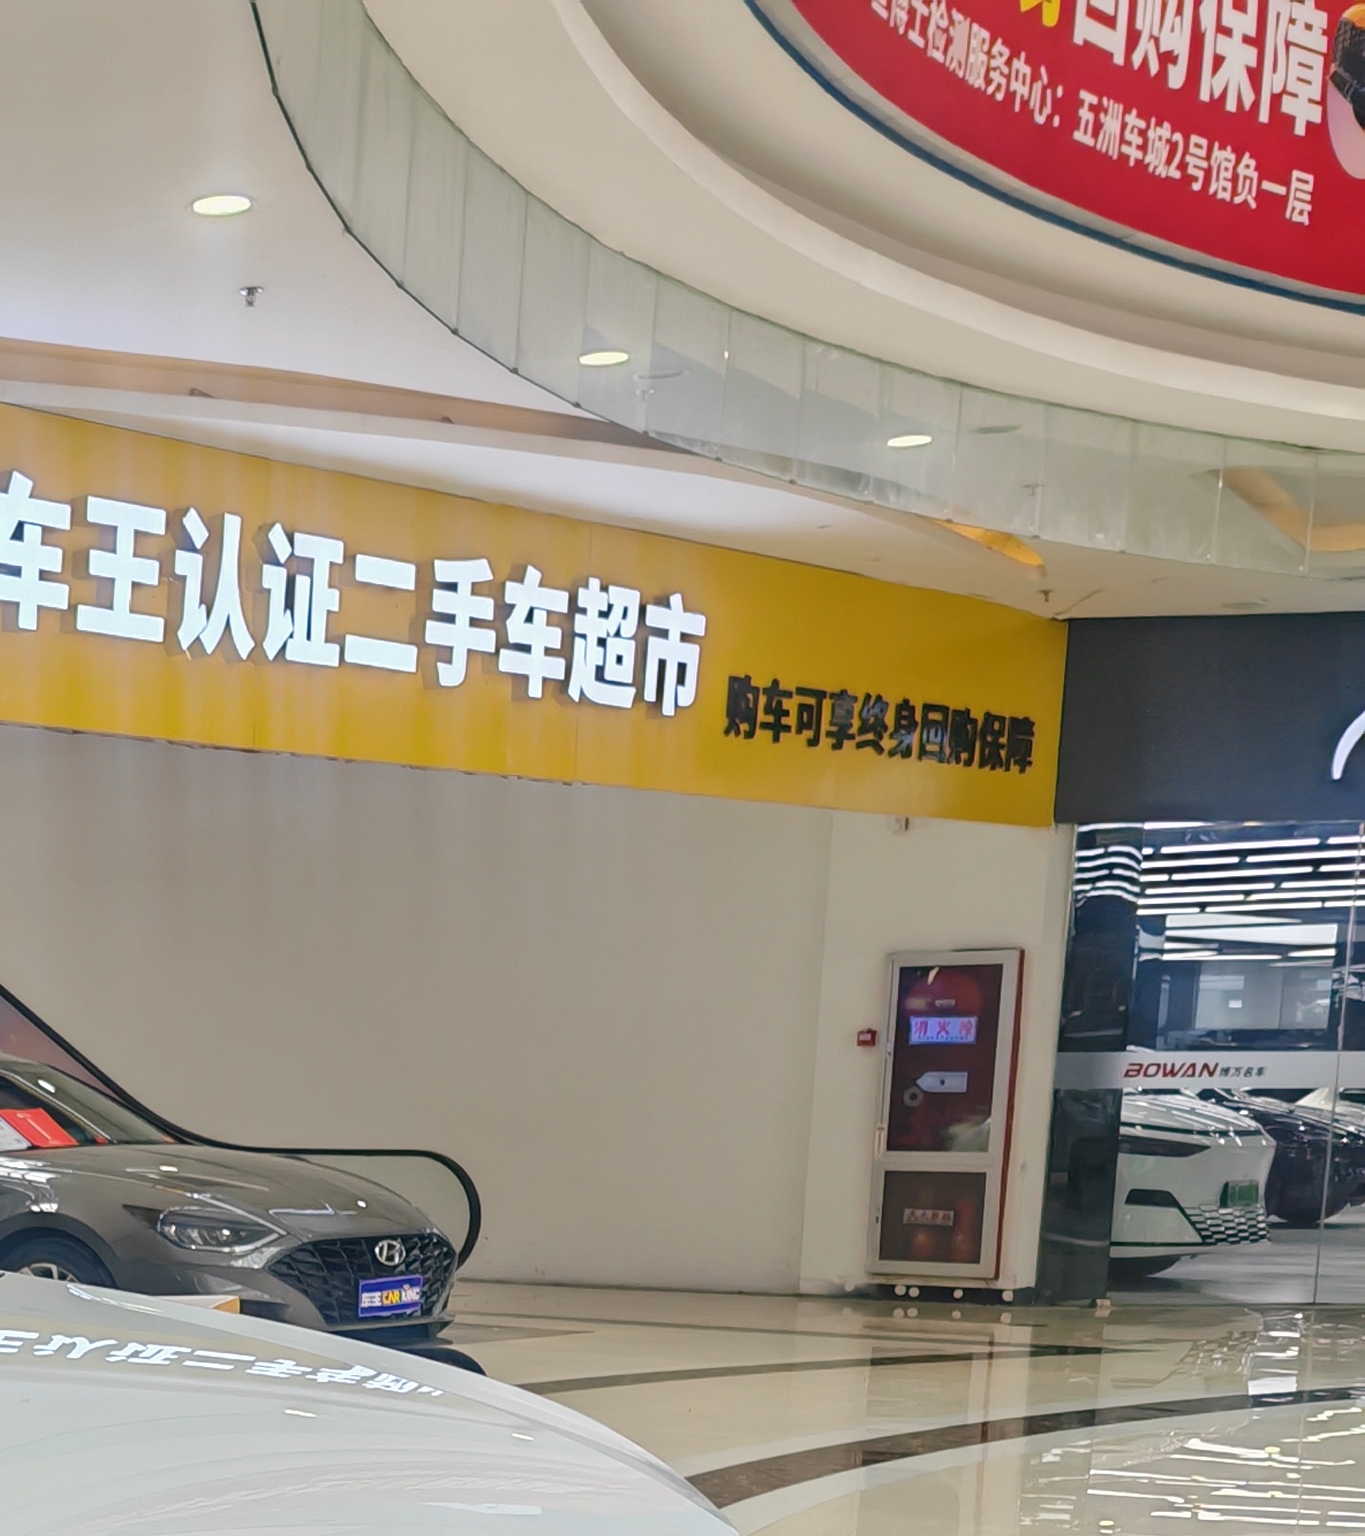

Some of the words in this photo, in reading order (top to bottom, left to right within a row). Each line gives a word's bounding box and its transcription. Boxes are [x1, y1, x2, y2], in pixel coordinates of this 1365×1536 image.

[1021, 0, 1327, 136] 回购保障
[723, 674, 1036, 775] 购车可享终身回购保障
[1123, 1062, 1219, 1078] BOWAN
